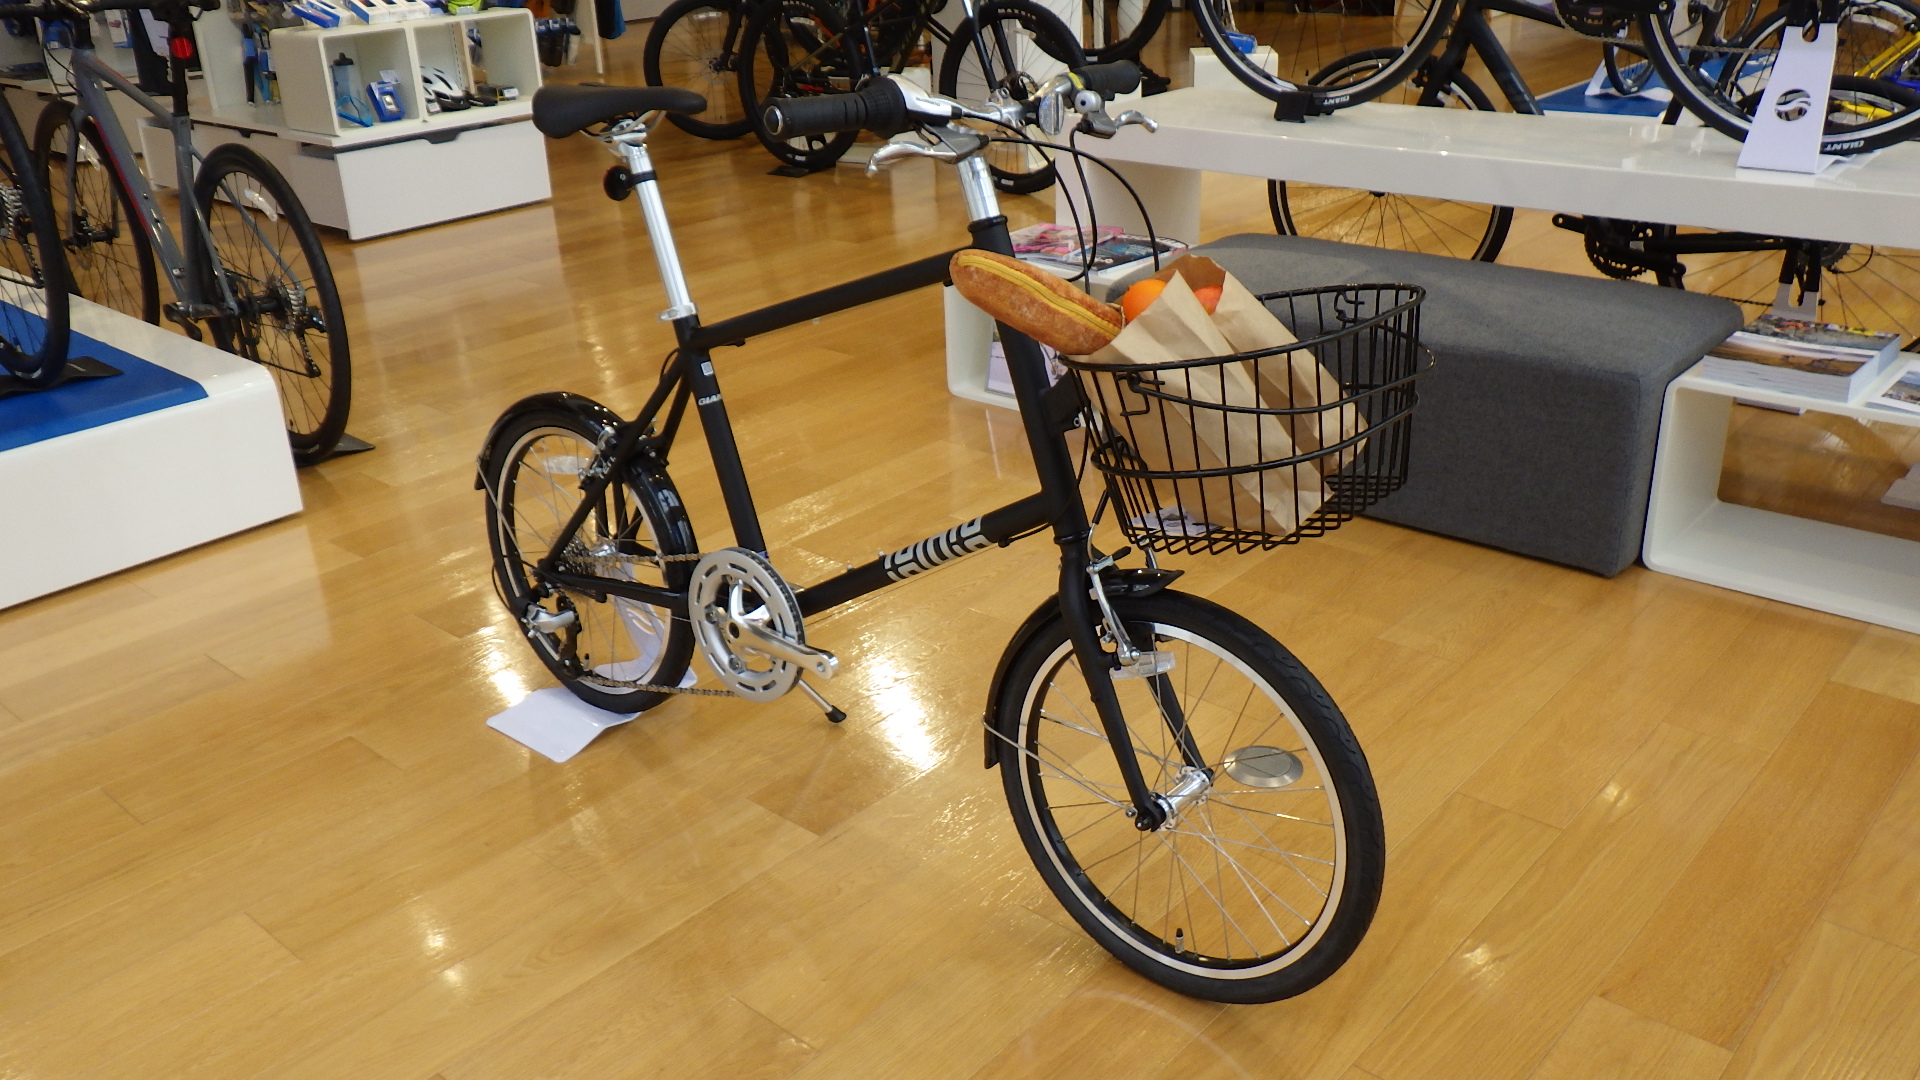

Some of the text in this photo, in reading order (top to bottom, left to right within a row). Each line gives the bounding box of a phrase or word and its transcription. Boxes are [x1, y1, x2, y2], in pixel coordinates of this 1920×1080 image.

[1323, 95, 1349, 105] GIANT
[1825, 140, 1864, 151] GIANT
[698, 394, 722, 405] GIAN
